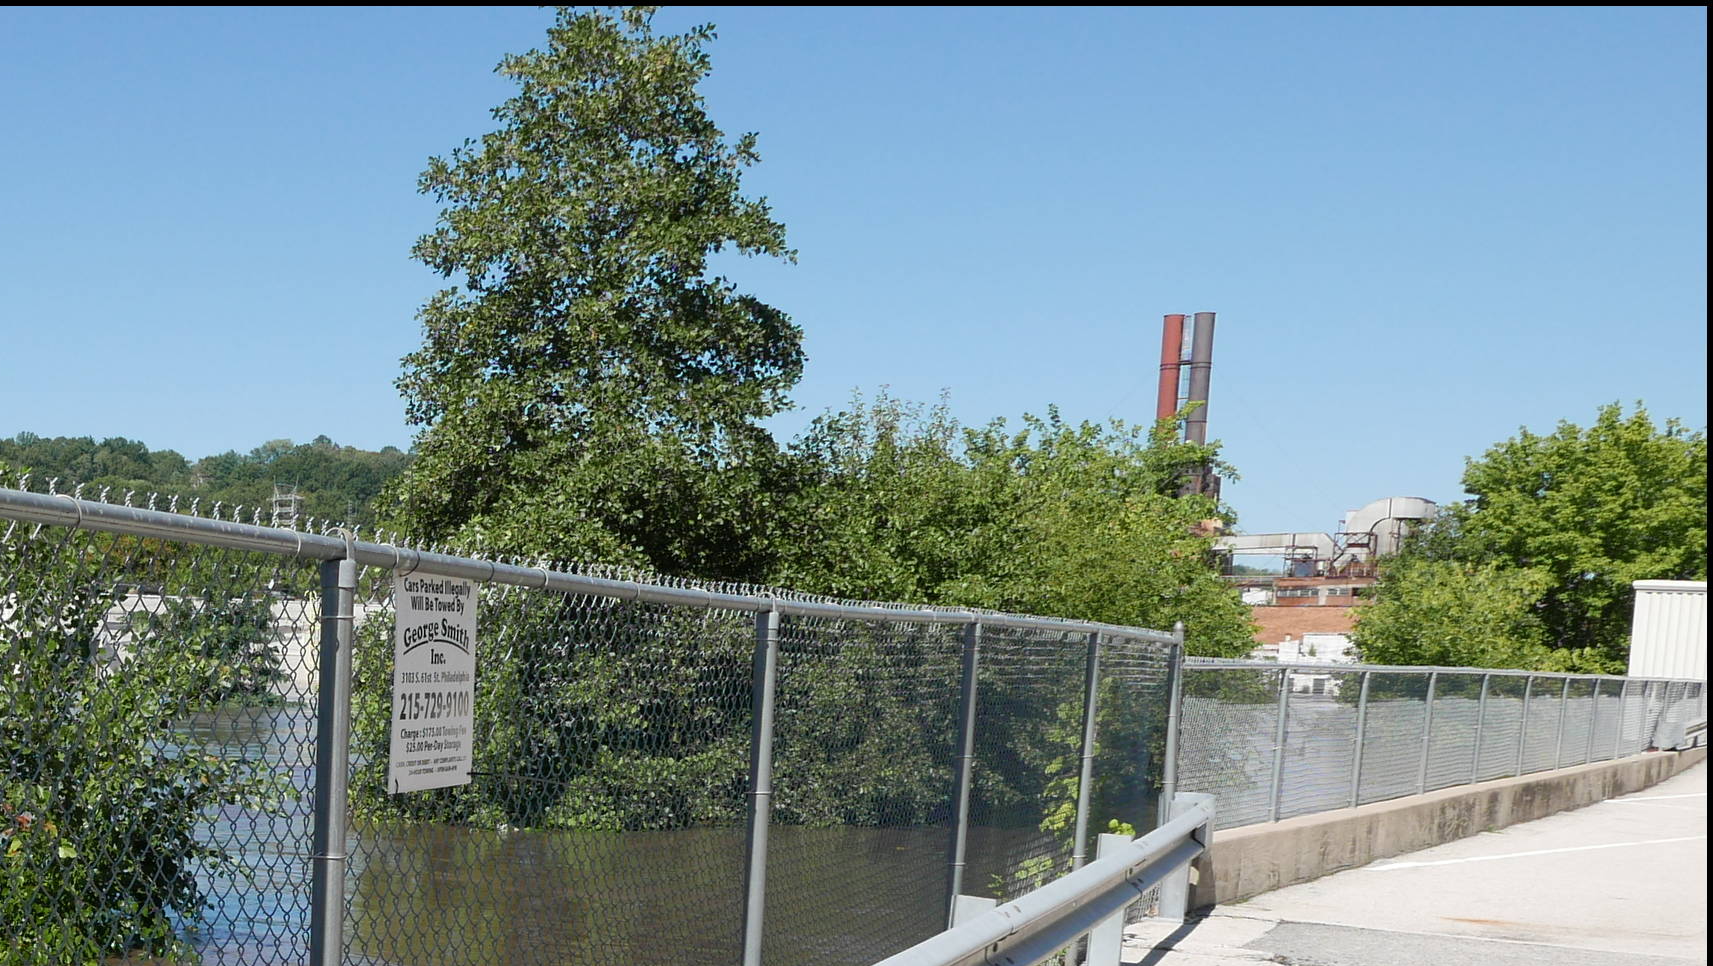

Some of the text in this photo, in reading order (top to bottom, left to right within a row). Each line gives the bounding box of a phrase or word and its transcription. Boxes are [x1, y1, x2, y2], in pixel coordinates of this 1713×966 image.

[404, 578, 470, 599] Cars Parked Illegally
[410, 596, 464, 616] Will Be Towed By
[404, 618, 469, 649] George Smith
[430, 648, 446, 664] Inc.
[400, 691, 469, 720] 215-729-9100
